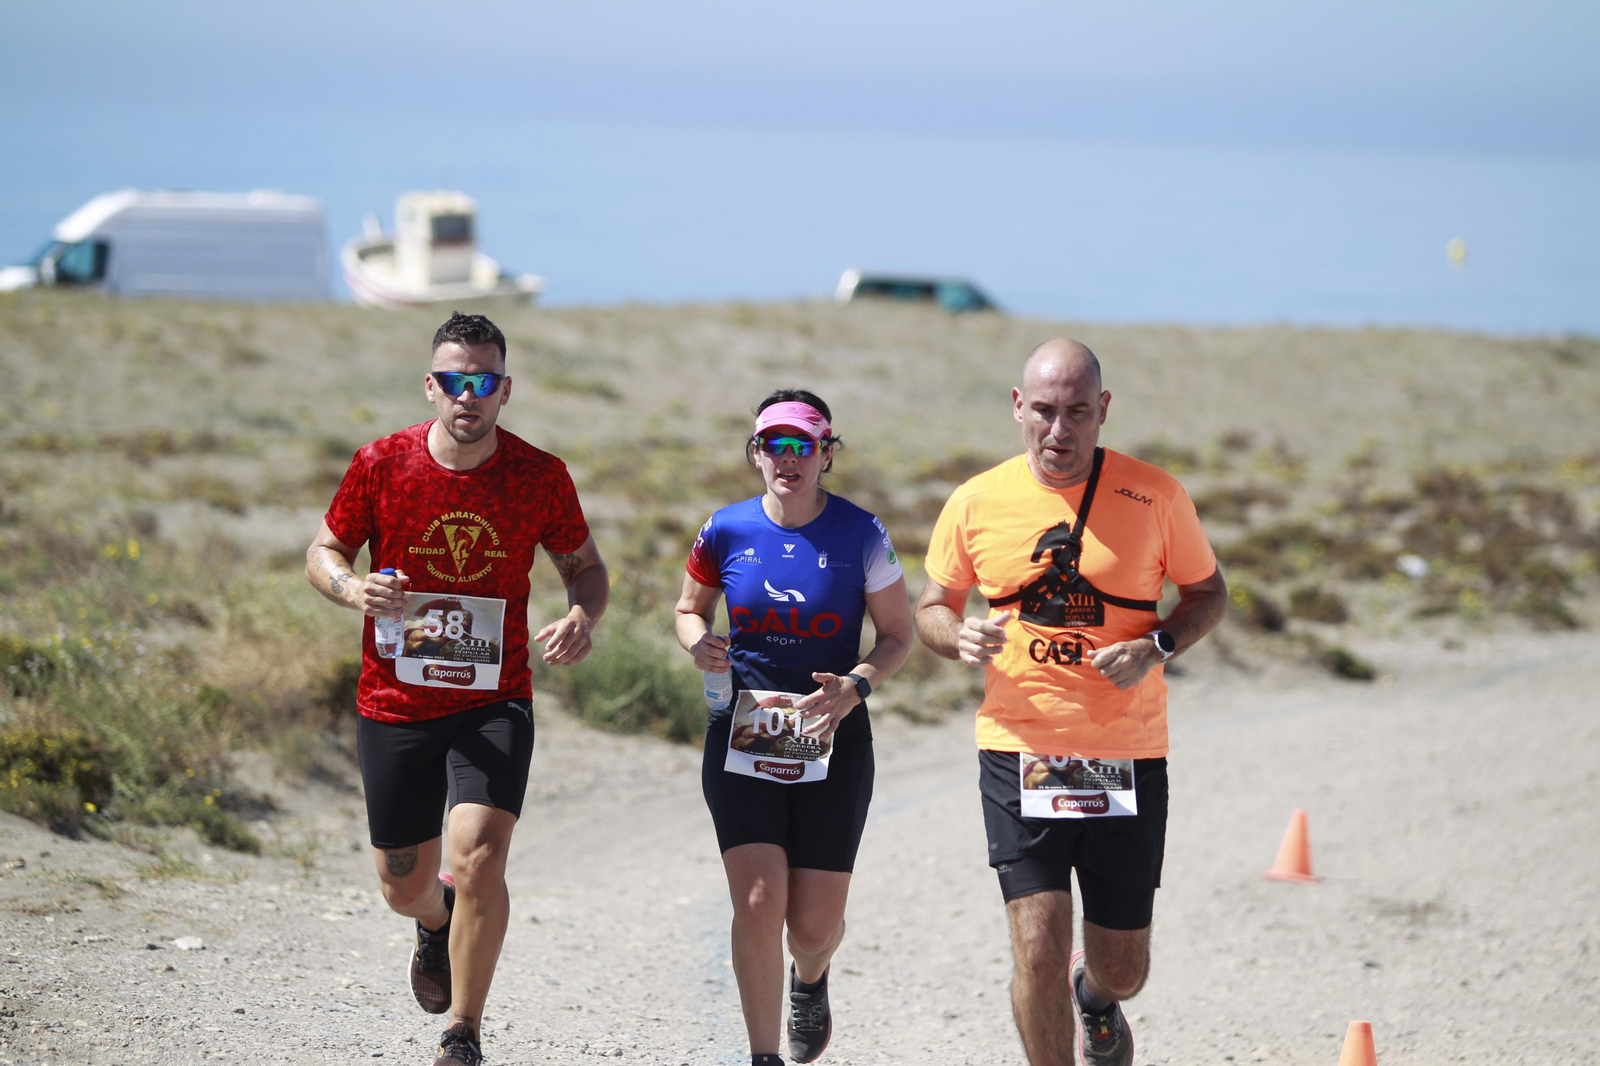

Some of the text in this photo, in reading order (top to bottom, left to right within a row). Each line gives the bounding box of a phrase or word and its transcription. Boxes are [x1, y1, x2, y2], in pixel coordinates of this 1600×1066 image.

[422, 511, 500, 546] CLUB MARATONIANO
[408, 546, 446, 555] CIUDAD
[484, 550, 508, 558] REAL
[735, 555, 762, 564] SPIRAL
[1067, 593, 1095, 606] XIII
[423, 609, 465, 640] 58
[731, 606, 843, 639] GALO
[455, 638, 491, 647] XIII
[1028, 638, 1083, 666] CASI
[748, 706, 803, 738] 101
[785, 736, 821, 745] XIII
[1084, 766, 1122, 774] XIII
